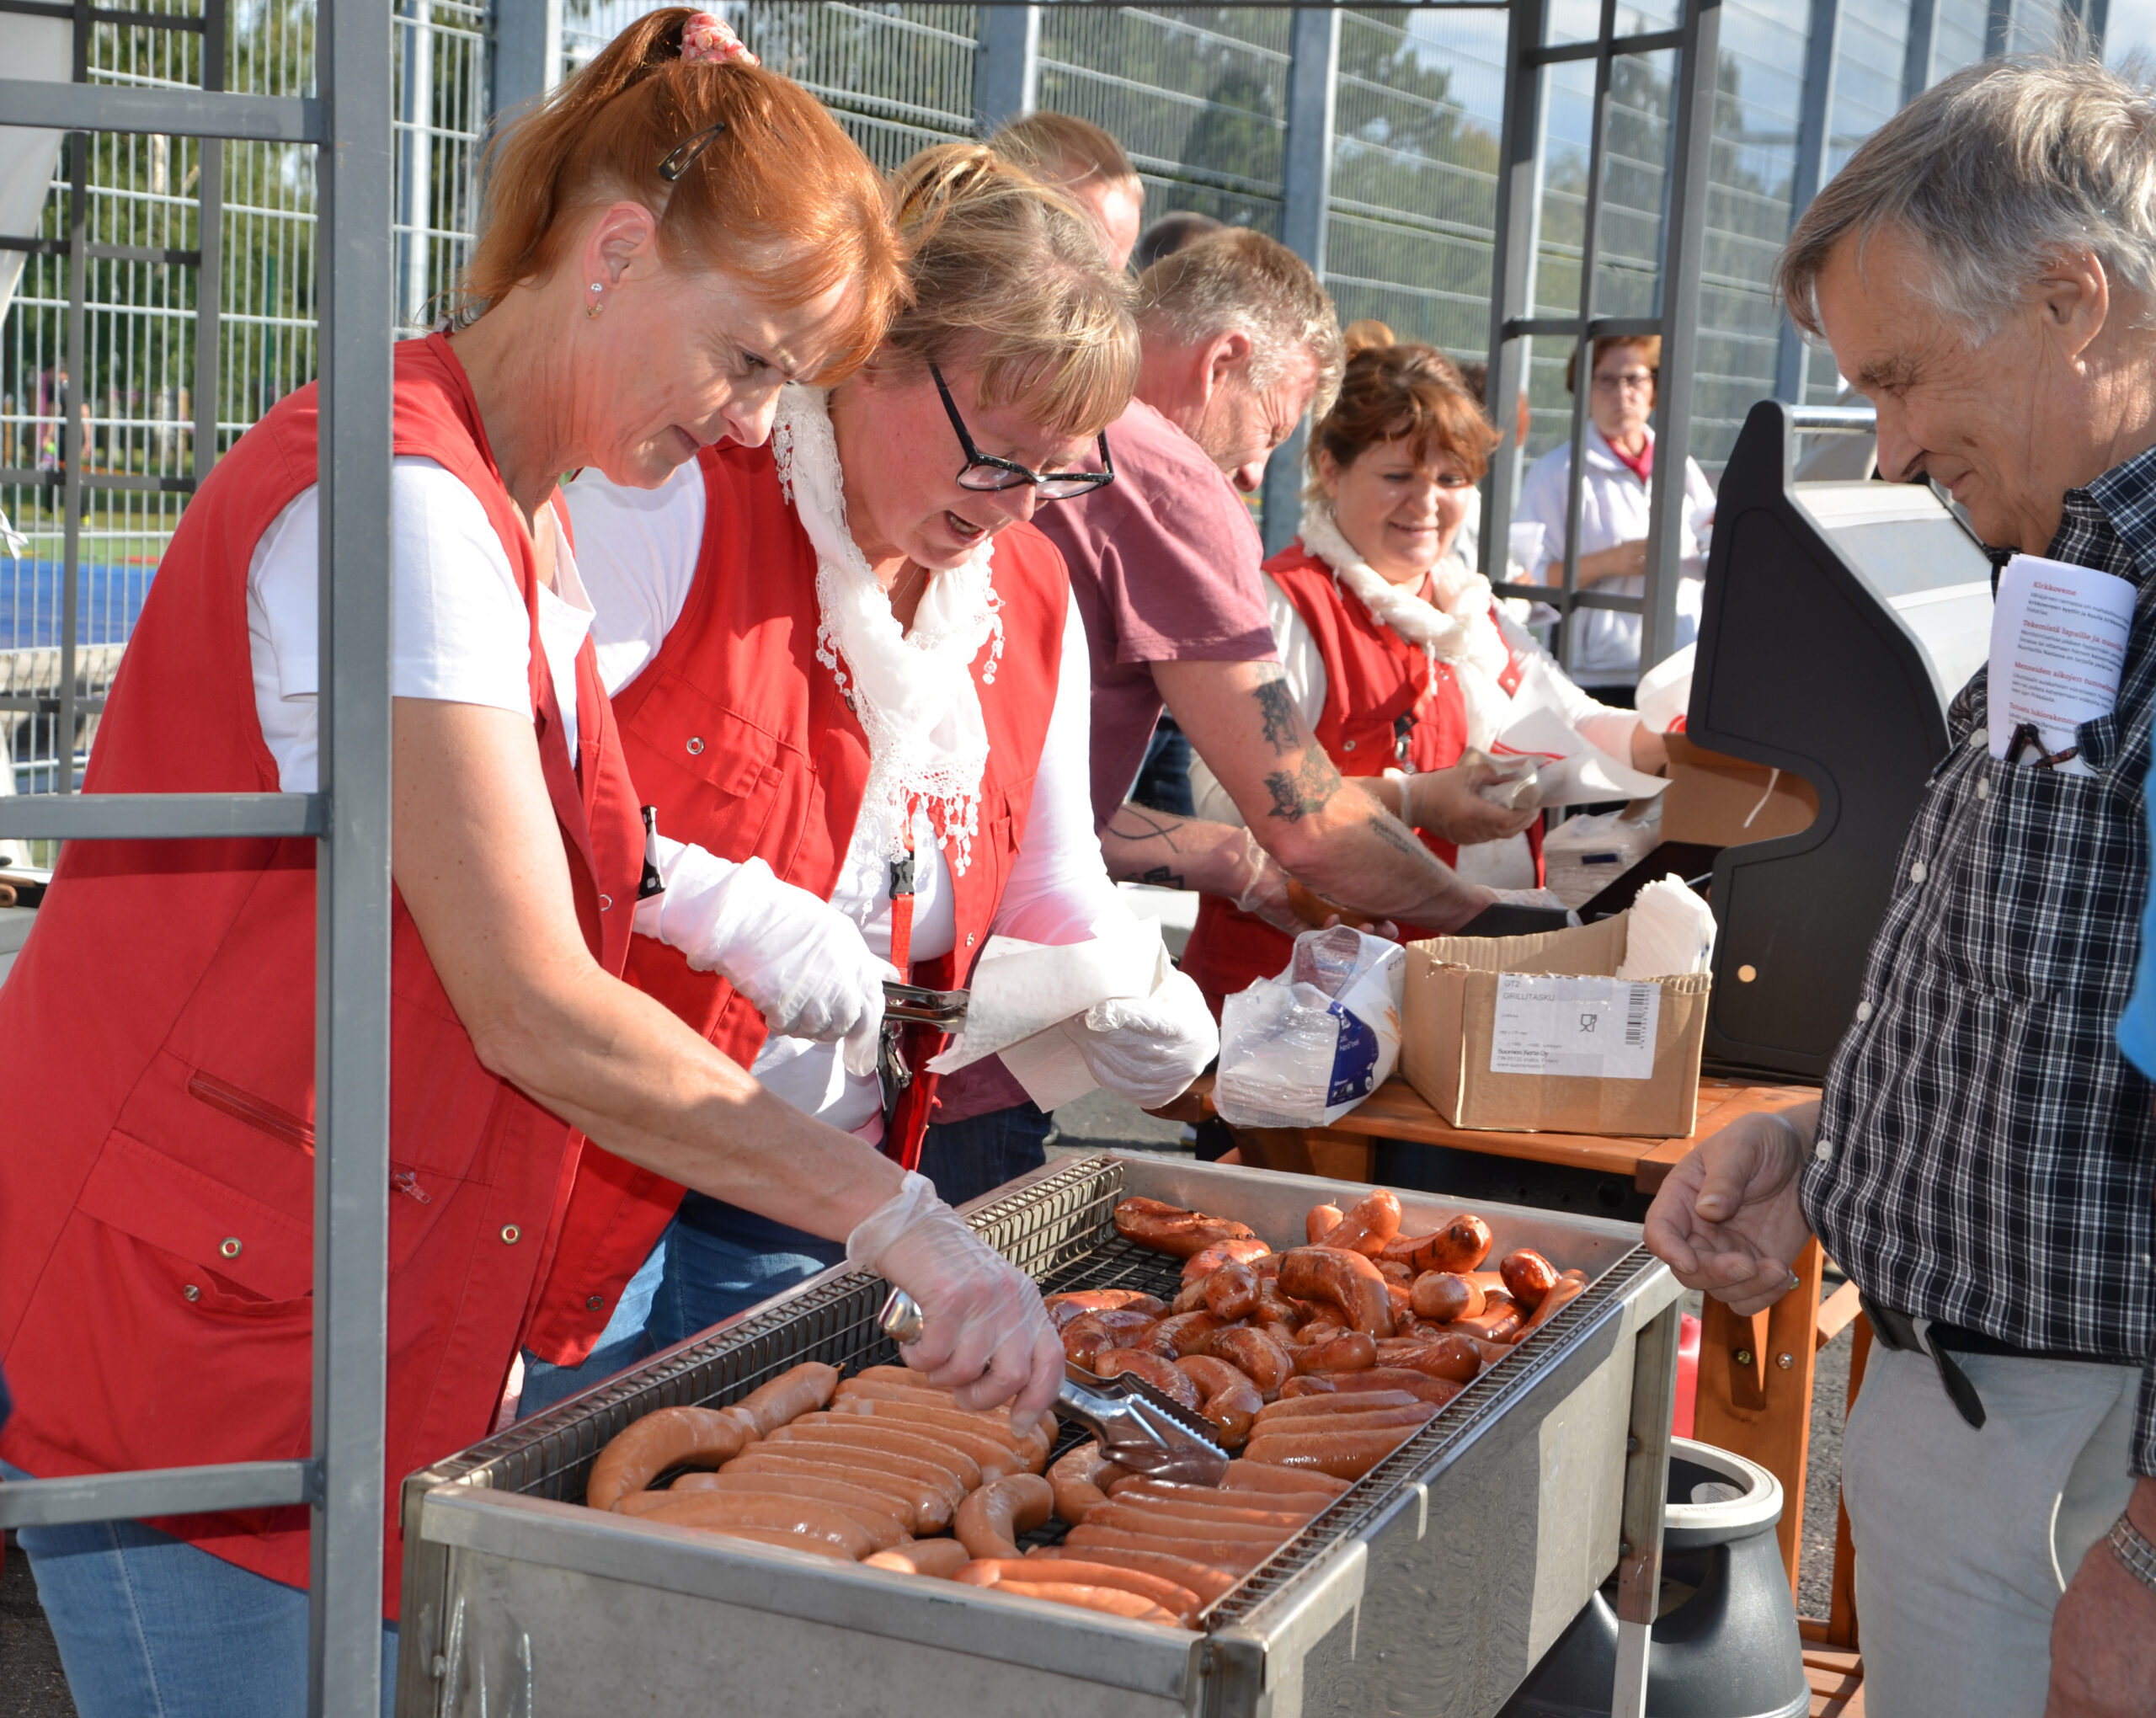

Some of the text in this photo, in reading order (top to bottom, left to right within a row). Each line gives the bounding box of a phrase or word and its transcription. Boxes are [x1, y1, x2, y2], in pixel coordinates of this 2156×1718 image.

[2033, 581, 2077, 596] Kirkkovene
[2023, 620, 2060, 634] Tekemistä
[2062, 627, 2091, 641] lapsille
[2091, 635, 2100, 643] ja
[2015, 661, 2052, 676] Menneiden
[2052, 671, 2083, 684] aikojen
[1503, 979, 1521, 988] GT2
